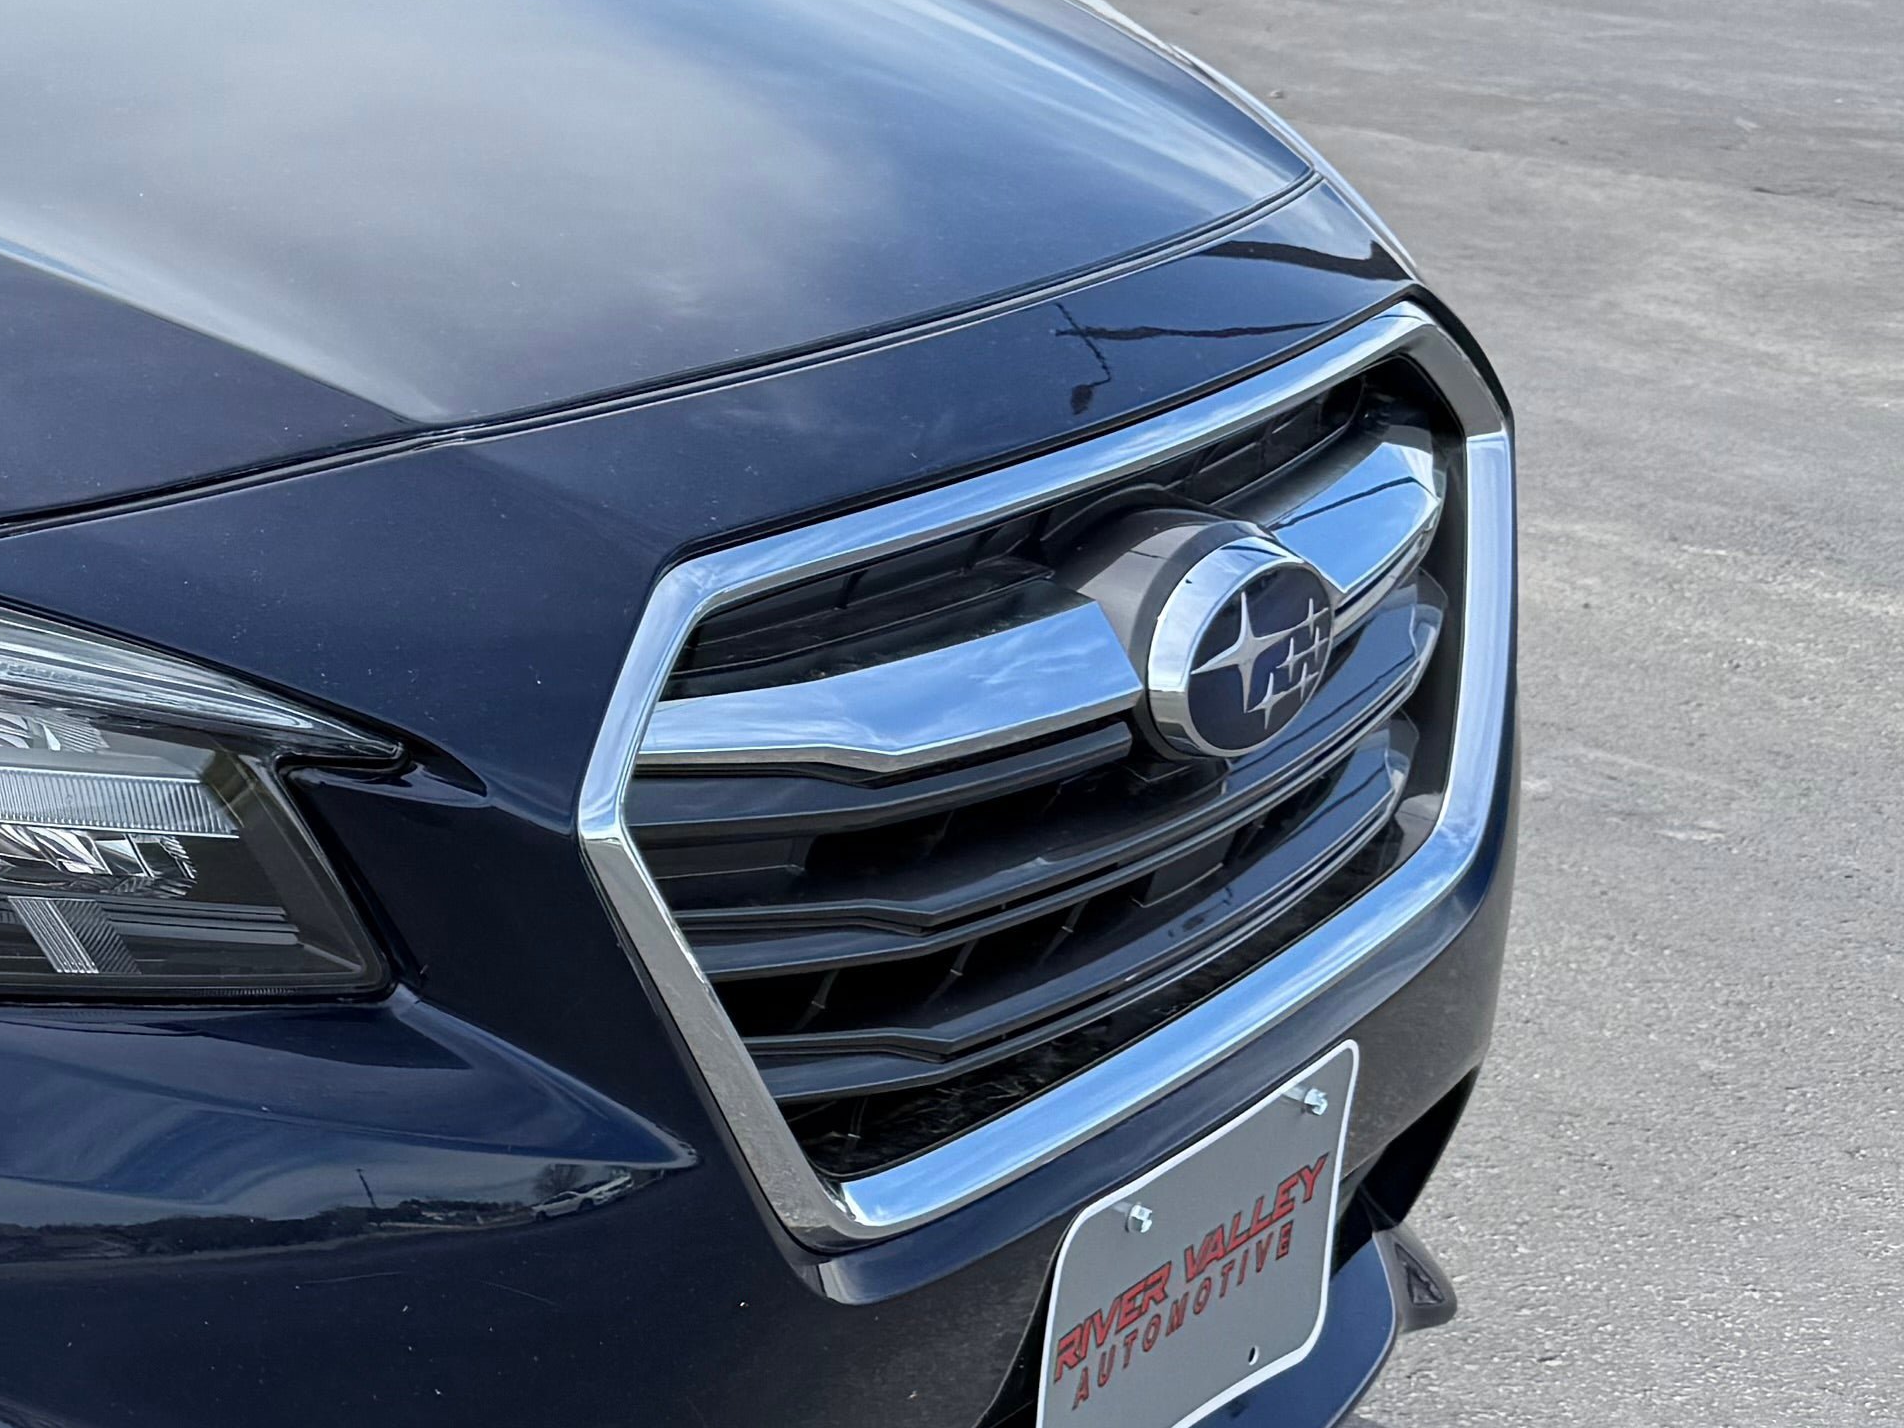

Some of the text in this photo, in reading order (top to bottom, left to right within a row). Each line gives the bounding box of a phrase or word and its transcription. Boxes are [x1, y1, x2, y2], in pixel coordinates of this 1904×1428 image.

[1053, 1151, 1330, 1384] RIVER VALLEY
[1072, 1219, 1294, 1410] AUTOMOTIVE
